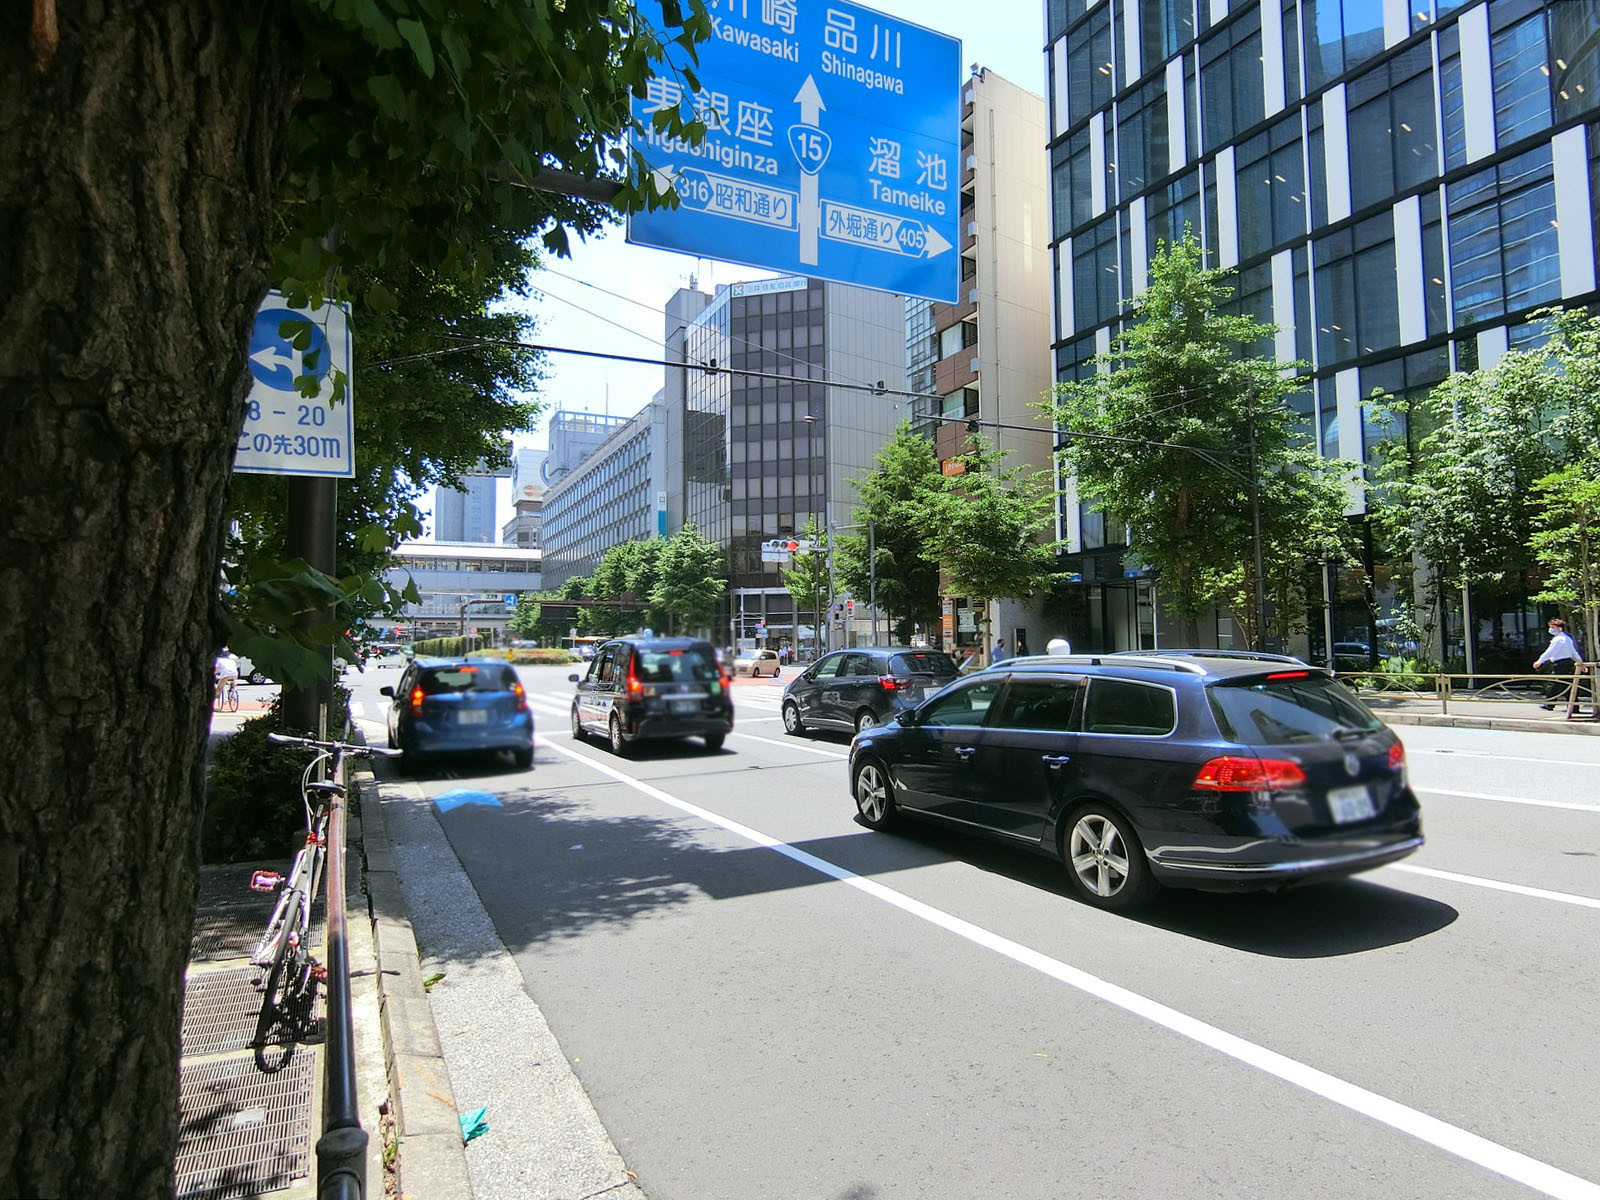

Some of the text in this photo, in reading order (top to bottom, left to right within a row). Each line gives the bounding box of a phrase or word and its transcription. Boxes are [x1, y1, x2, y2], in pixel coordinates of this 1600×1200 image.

[709, 14, 799, 63] Kawasaki
[825, 8, 901, 69] 品川
[821, 51, 904, 95] Shinagawa
[642, 76, 773, 147] 東銀座
[797, 132, 823, 161] 15
[869, 136, 947, 191] 溜池
[680, 177, 788, 220] 316 昭和通り
[869, 178, 946, 216] Tameike
[830, 209, 925, 249] 外堀通り 405
